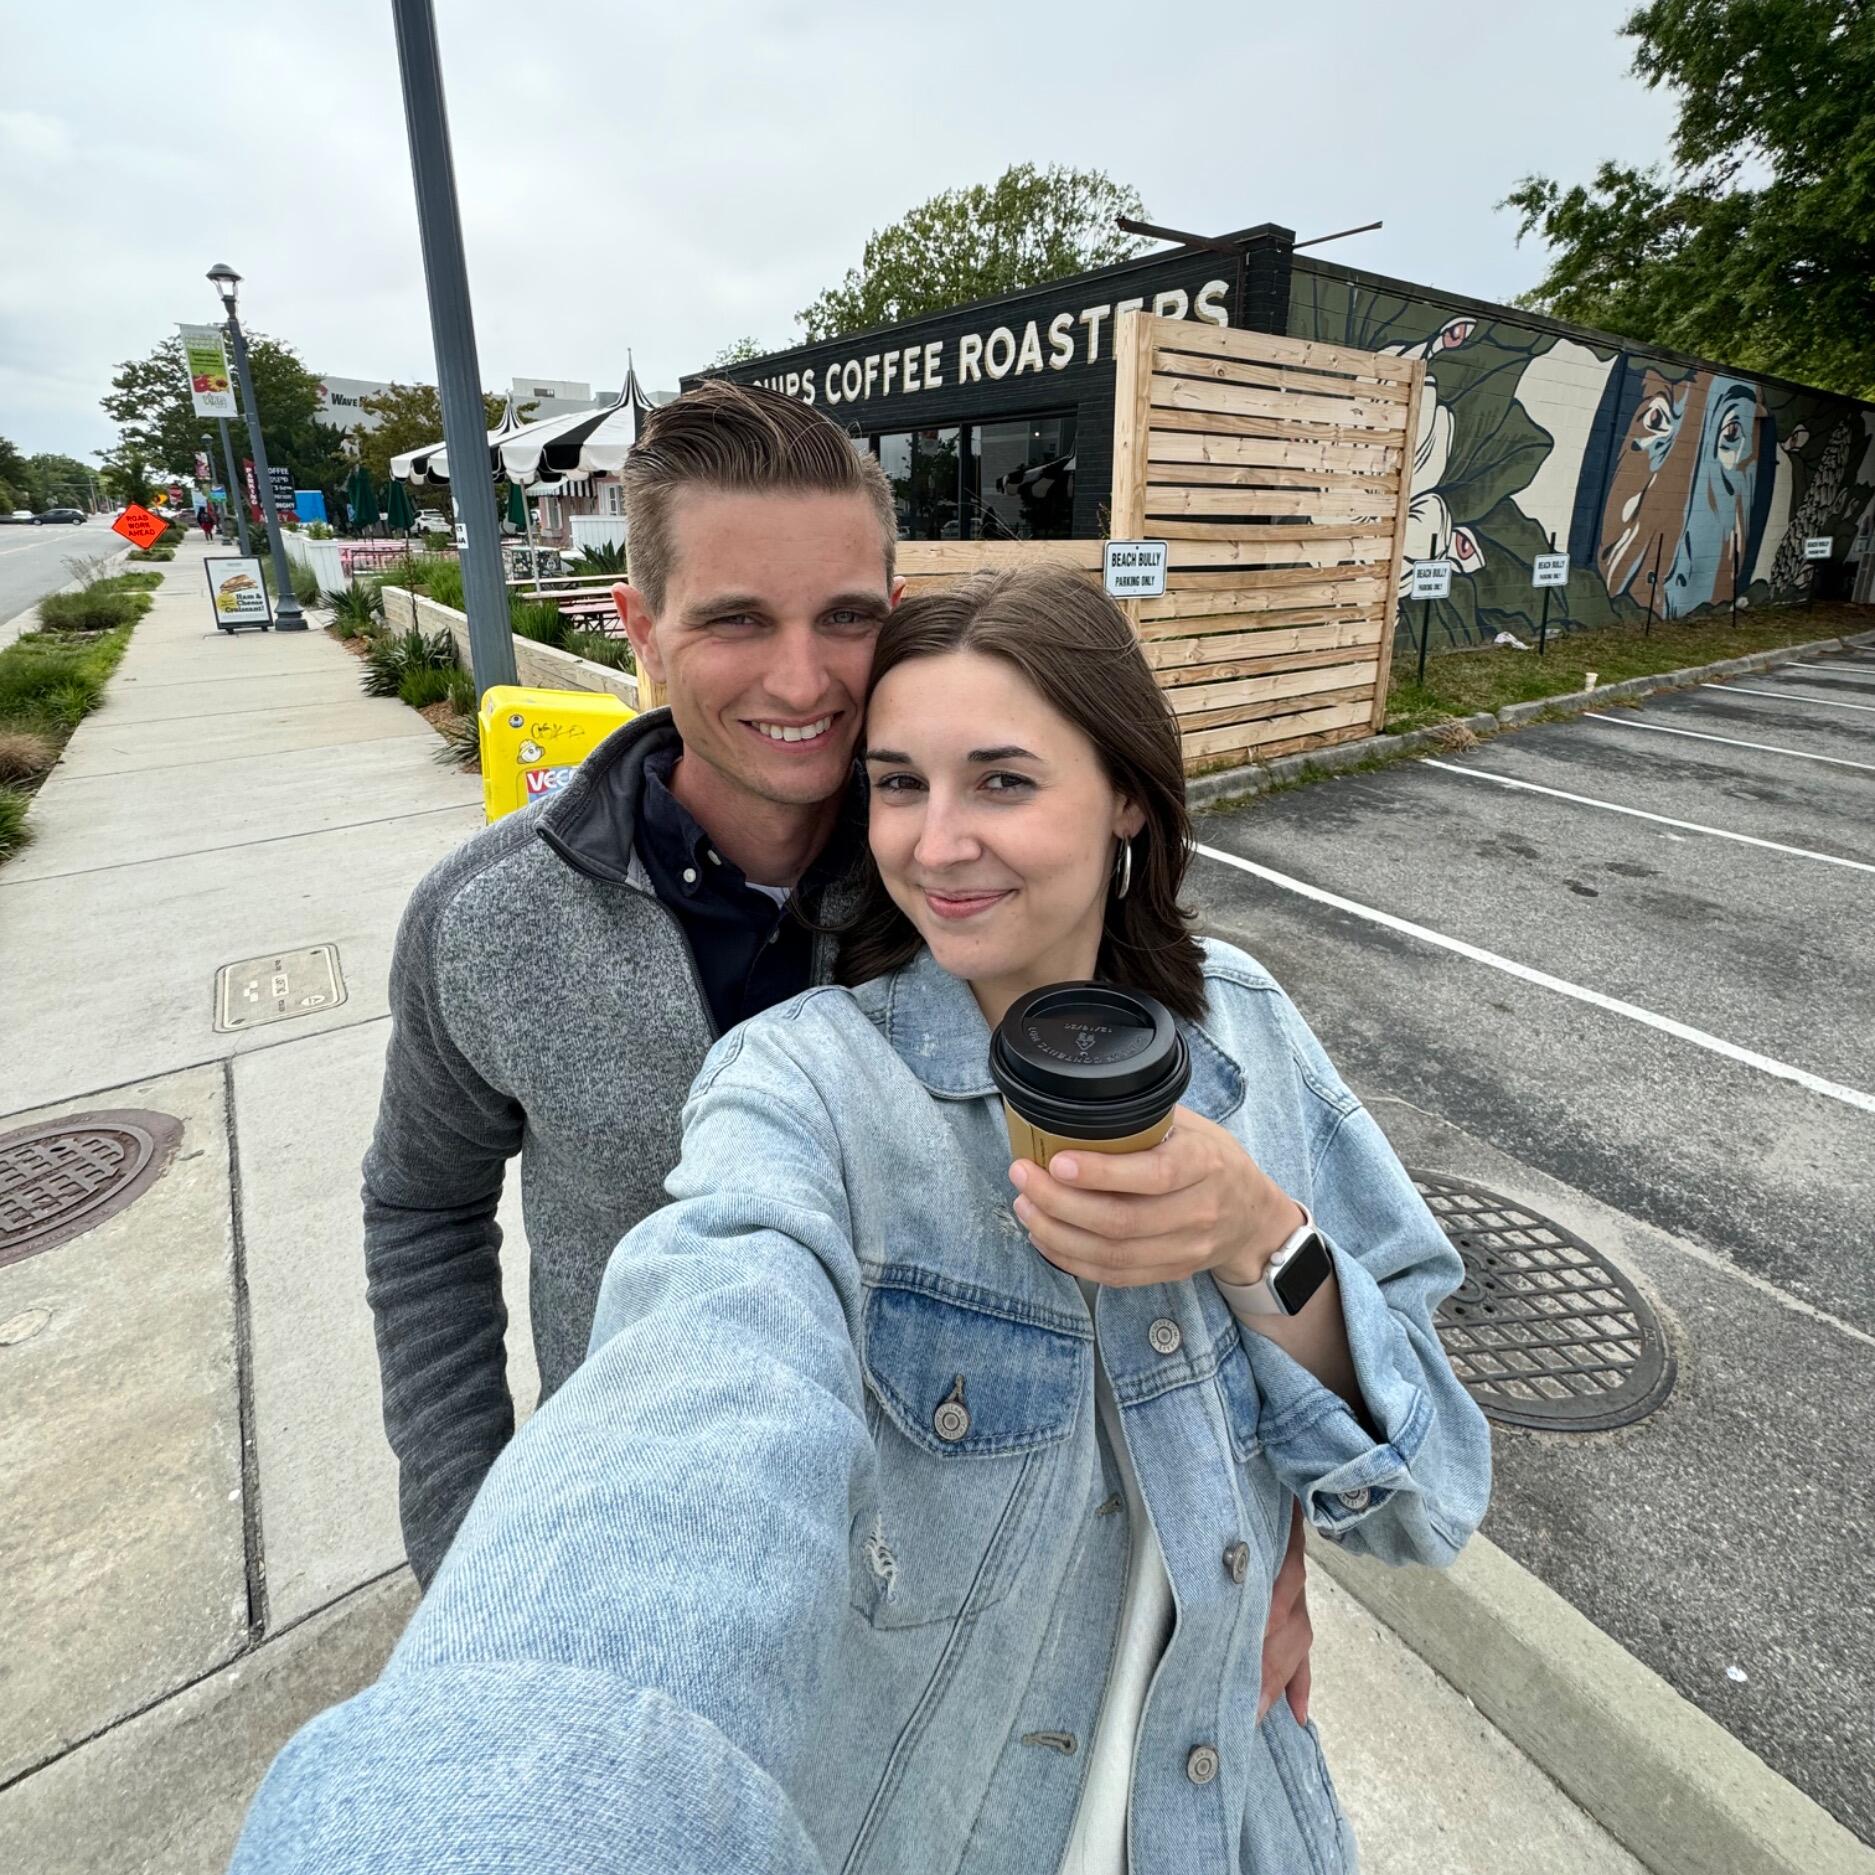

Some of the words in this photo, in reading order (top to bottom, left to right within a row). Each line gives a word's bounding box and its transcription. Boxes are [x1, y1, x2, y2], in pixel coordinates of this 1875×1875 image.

[825, 341, 943, 406] COFFEE
[267, 467, 289, 475] OFFEE
[1111, 552, 1137, 567] BEACH
[1138, 552, 1161, 567] BULLY
[1115, 576, 1140, 587] PARKING
[1141, 575, 1156, 587] ONLY
